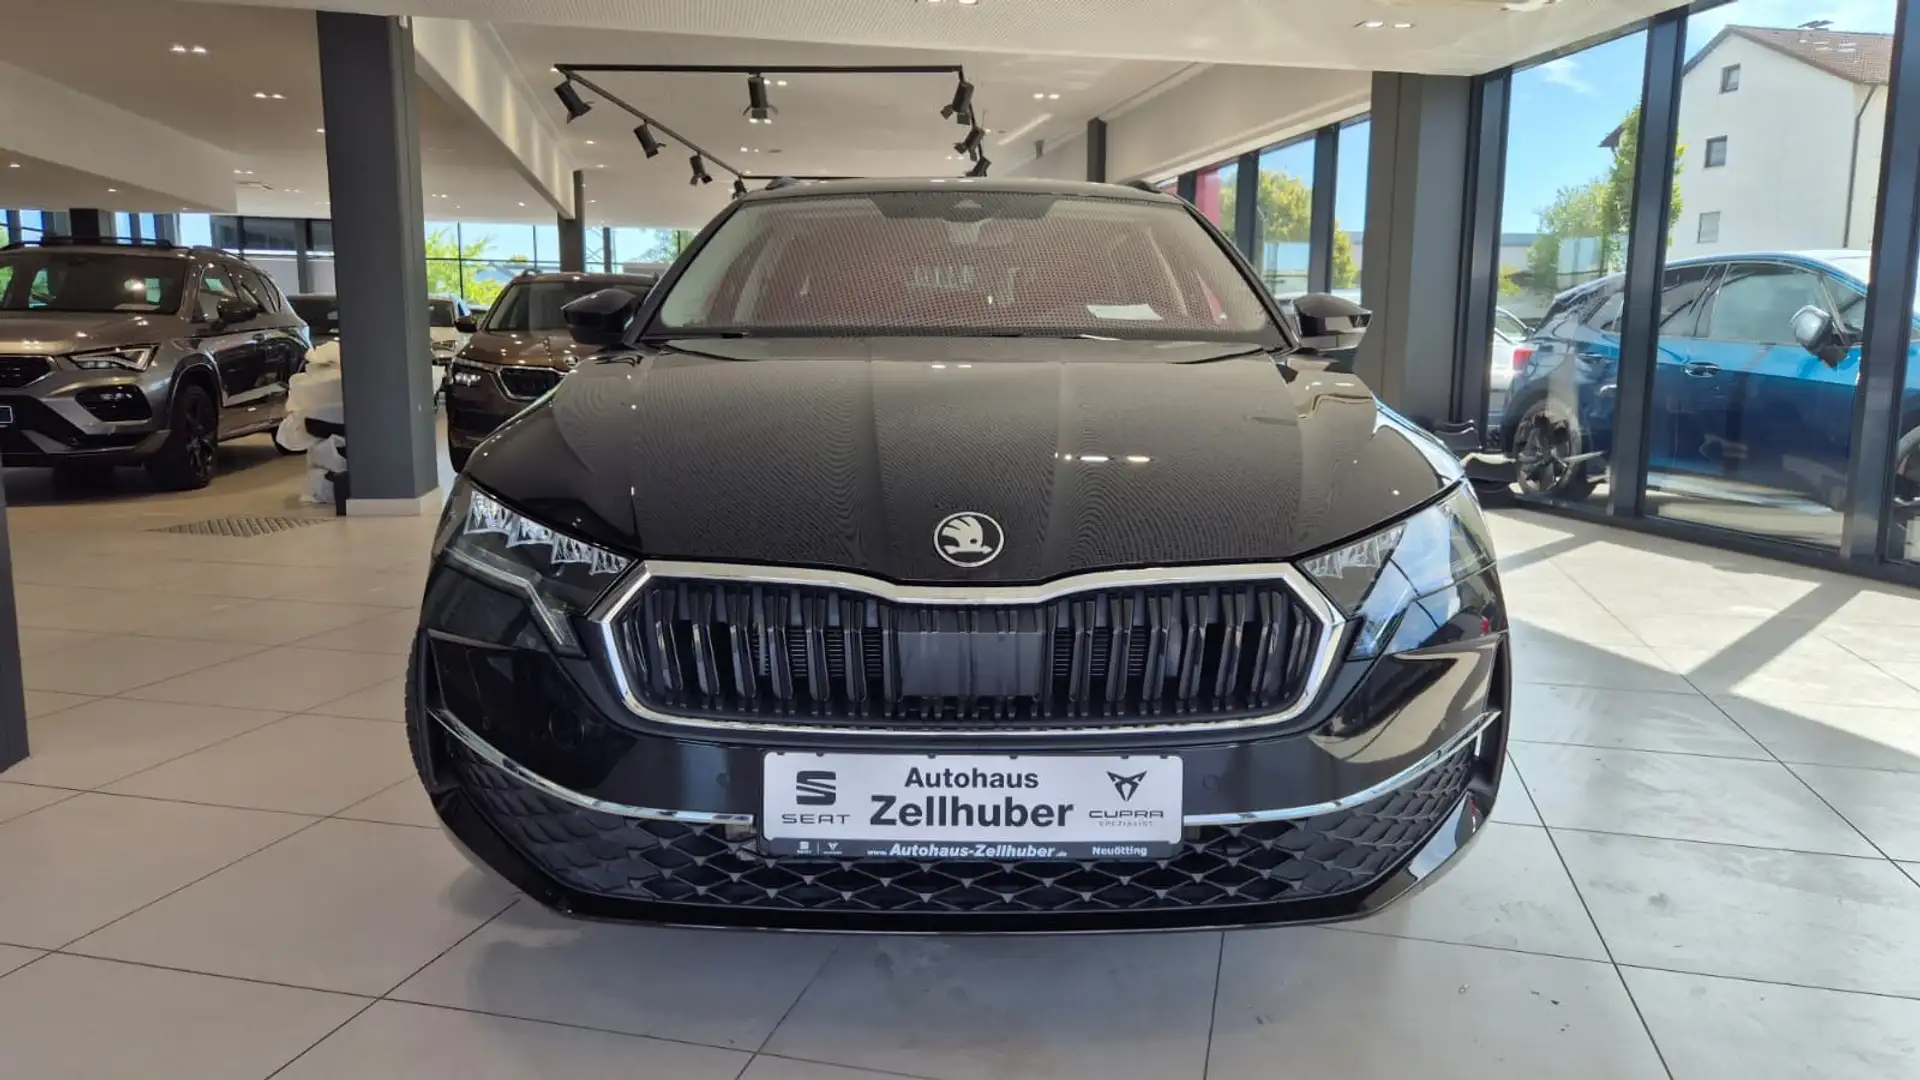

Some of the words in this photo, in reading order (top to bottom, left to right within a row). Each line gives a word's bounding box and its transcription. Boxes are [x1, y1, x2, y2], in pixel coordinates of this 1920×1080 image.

[904, 767, 1039, 788] Autohaus
[870, 795, 1074, 827] Zellhuber
[1088, 810, 1164, 819] CUPRA
[781, 814, 850, 825] SEAT
